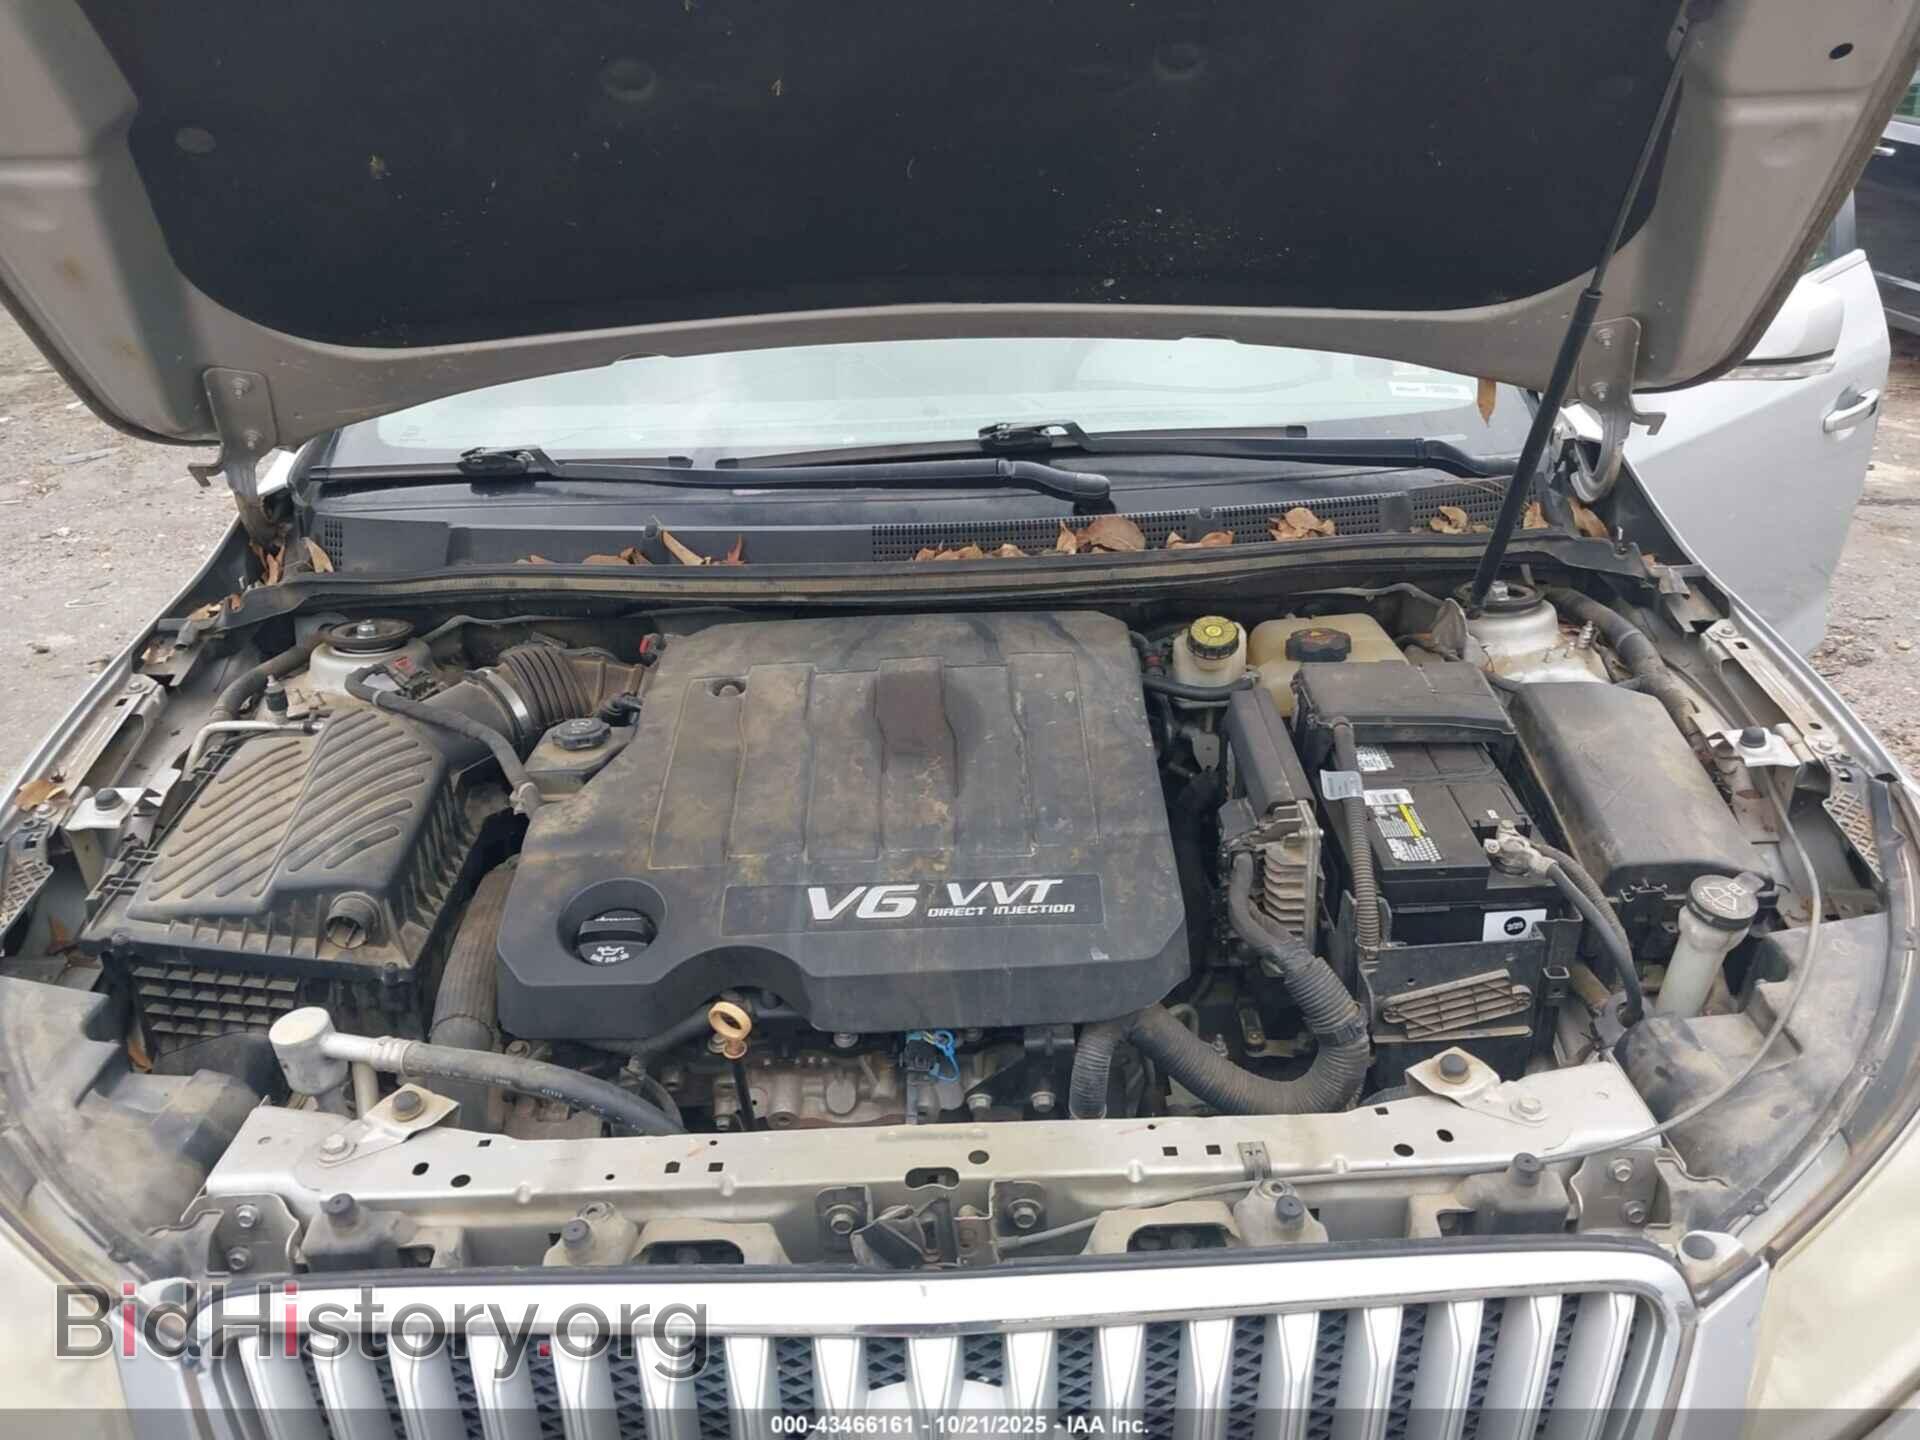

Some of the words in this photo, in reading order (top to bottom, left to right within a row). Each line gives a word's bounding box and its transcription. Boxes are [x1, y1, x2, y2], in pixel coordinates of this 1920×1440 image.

[807, 884, 920, 920] V6
[946, 879, 1064, 906] VVT
[927, 907, 987, 918] DIRECT
[993, 903, 1076, 915] INJECTION
